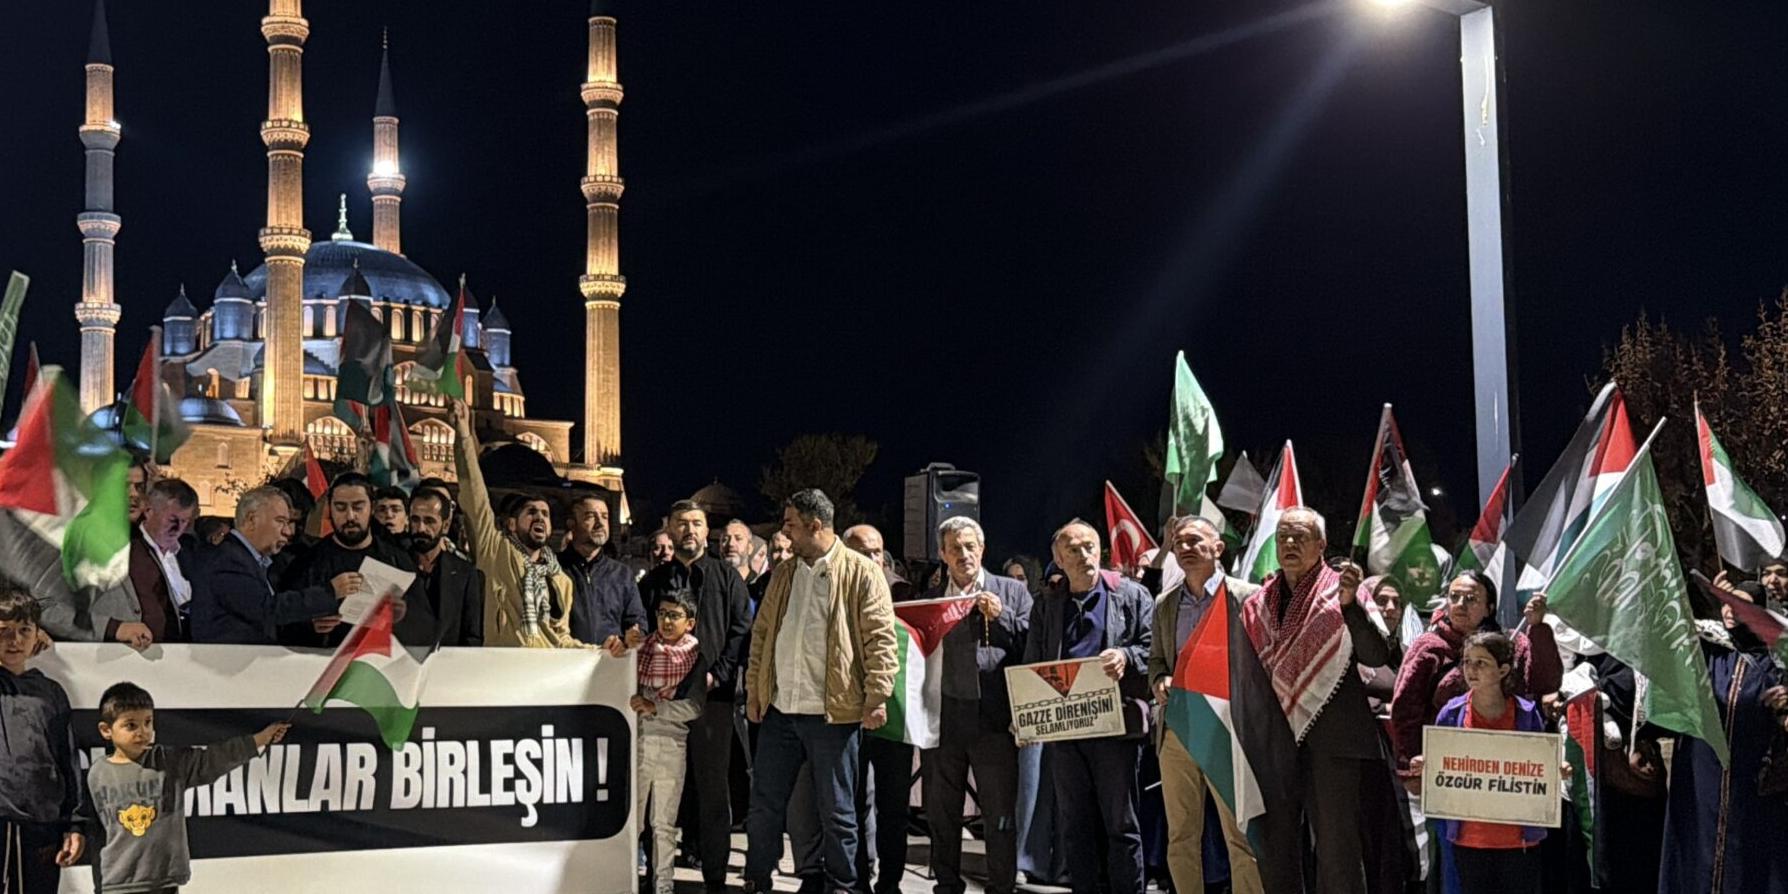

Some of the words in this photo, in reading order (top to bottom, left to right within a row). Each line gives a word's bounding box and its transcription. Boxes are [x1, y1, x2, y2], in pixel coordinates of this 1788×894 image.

[1018, 708, 1052, 728] GAZZE
[1055, 694, 1114, 720] DİRENİŞİNİ
[1035, 716, 1094, 735] SELAMLIYORUZ
[390, 724, 583, 828] BİRLEŞİN
[596, 737, 609, 802] !
[1442, 755, 1500, 774] NEHİRDEN
[1503, 760, 1545, 777] DENİZE
[1435, 770, 1483, 790] ÖZGÜR
[1488, 775, 1547, 795] FİLİSTİN
